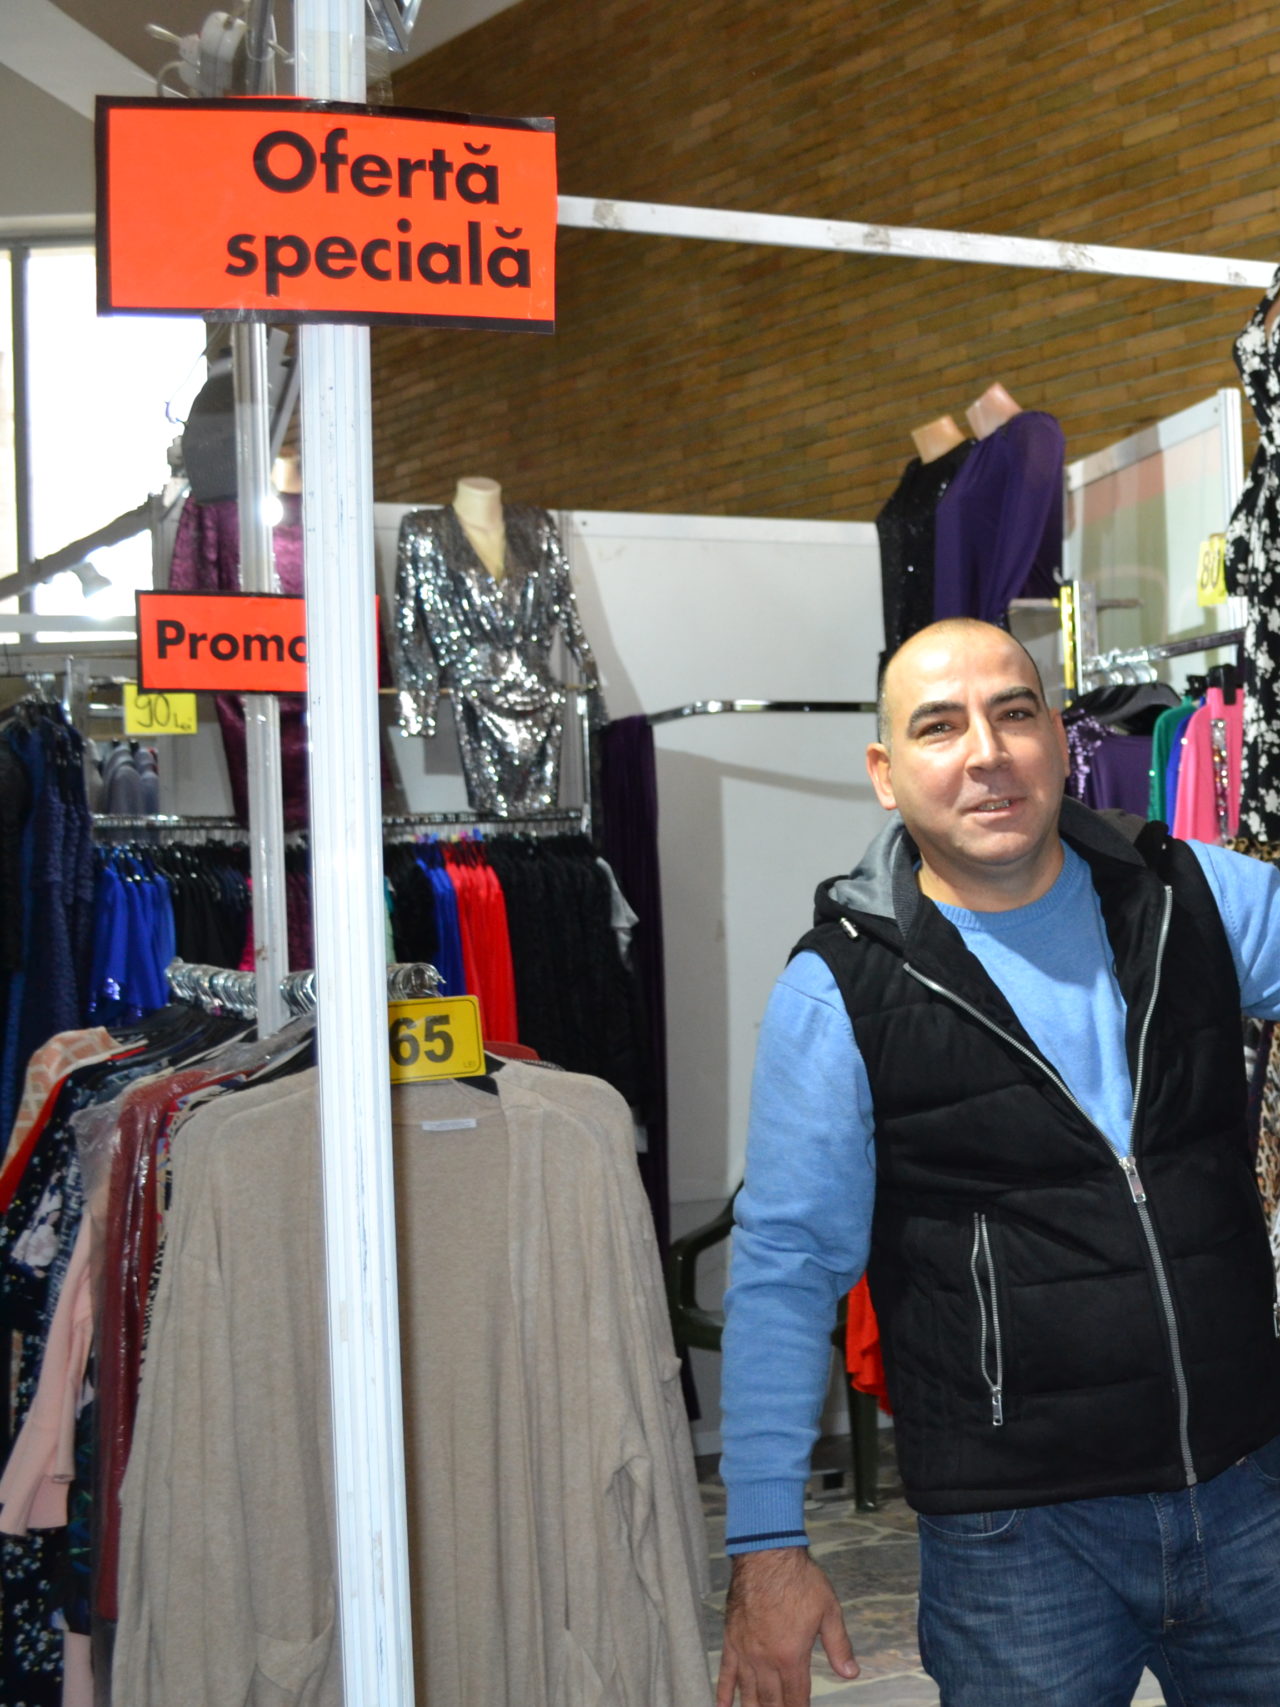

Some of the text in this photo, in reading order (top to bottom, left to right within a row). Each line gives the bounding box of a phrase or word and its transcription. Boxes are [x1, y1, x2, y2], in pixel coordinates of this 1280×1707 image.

[253, 128, 499, 205] Ofertă
[225, 218, 531, 297] specială
[134, 694, 170, 728] 90
[389, 1014, 454, 1067] 65
